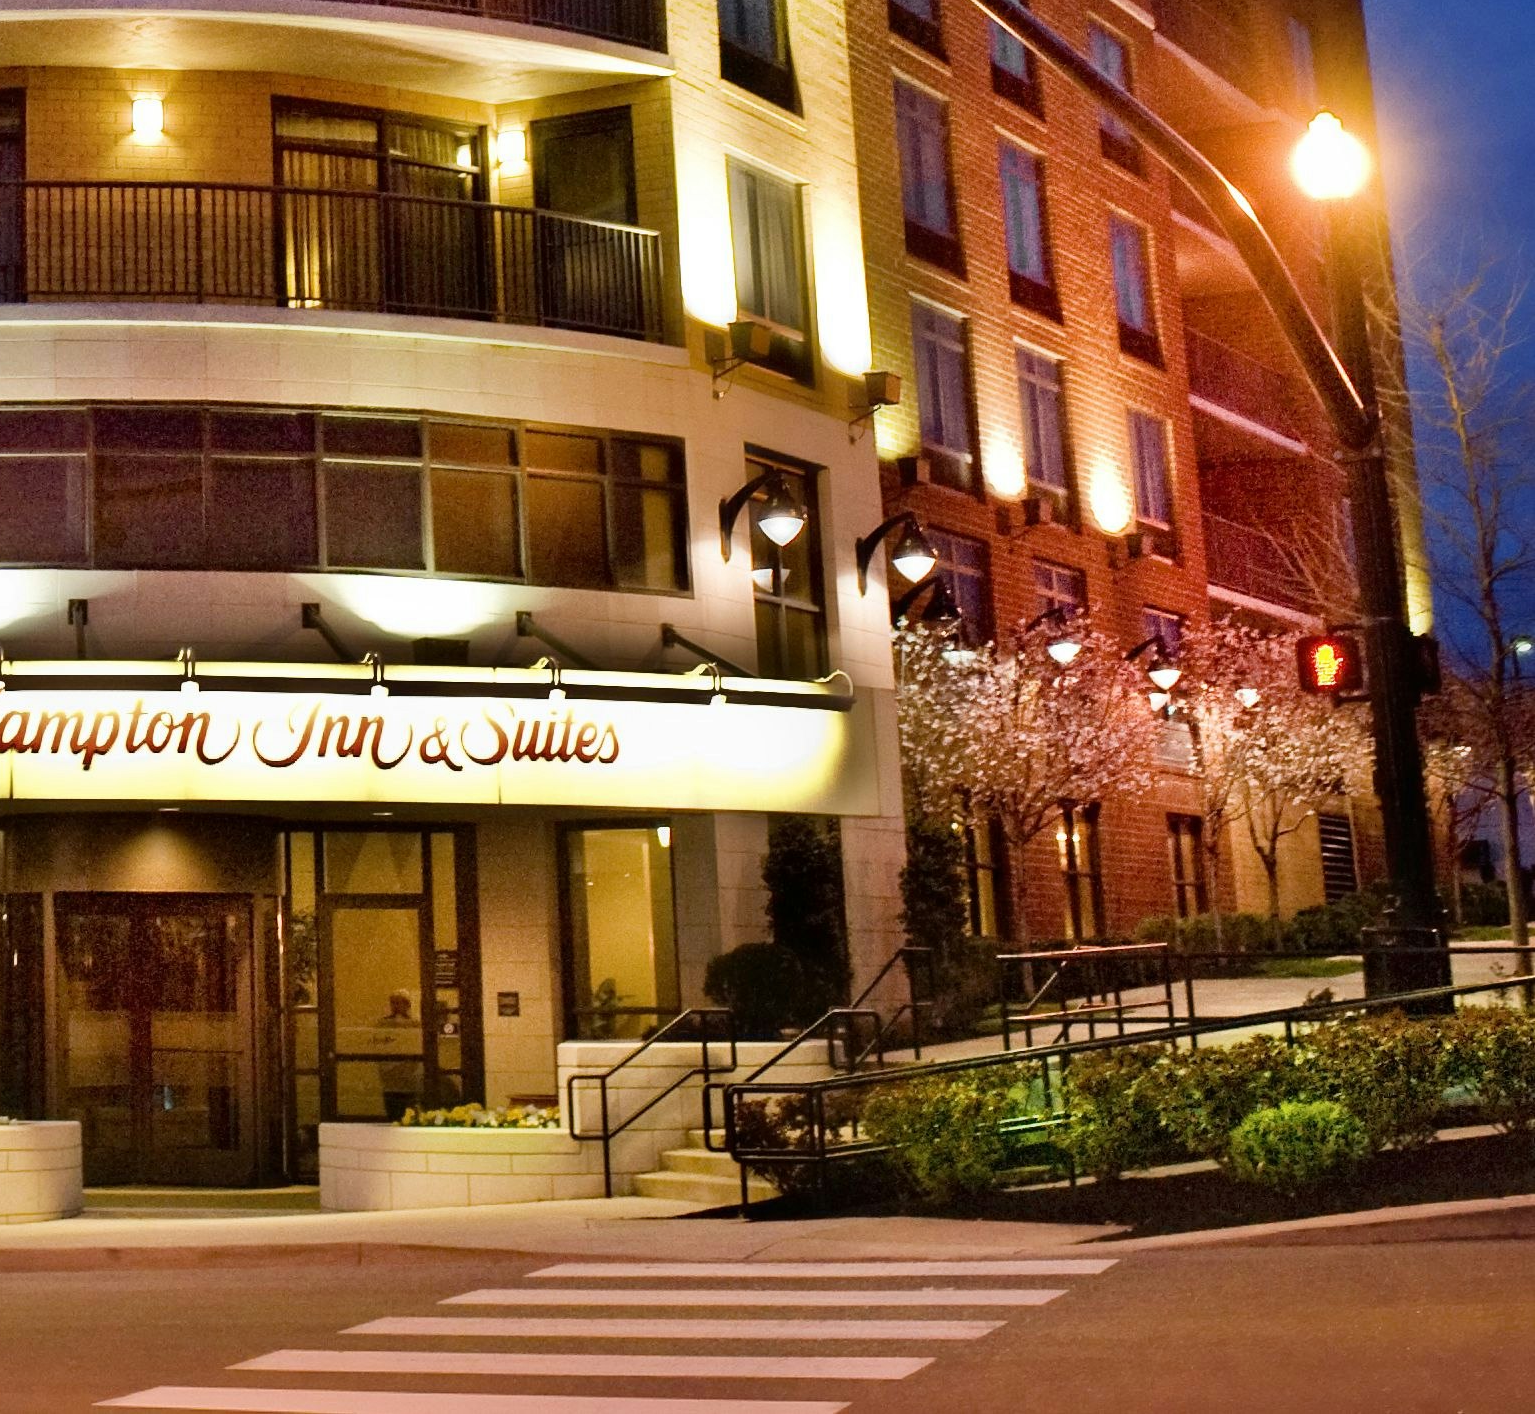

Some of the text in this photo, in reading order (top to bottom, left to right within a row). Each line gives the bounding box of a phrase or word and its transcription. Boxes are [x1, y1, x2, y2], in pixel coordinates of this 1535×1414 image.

[253, 700, 414, 771] Inn
[419, 716, 464, 772] &
[460, 700, 621, 766] Suites
